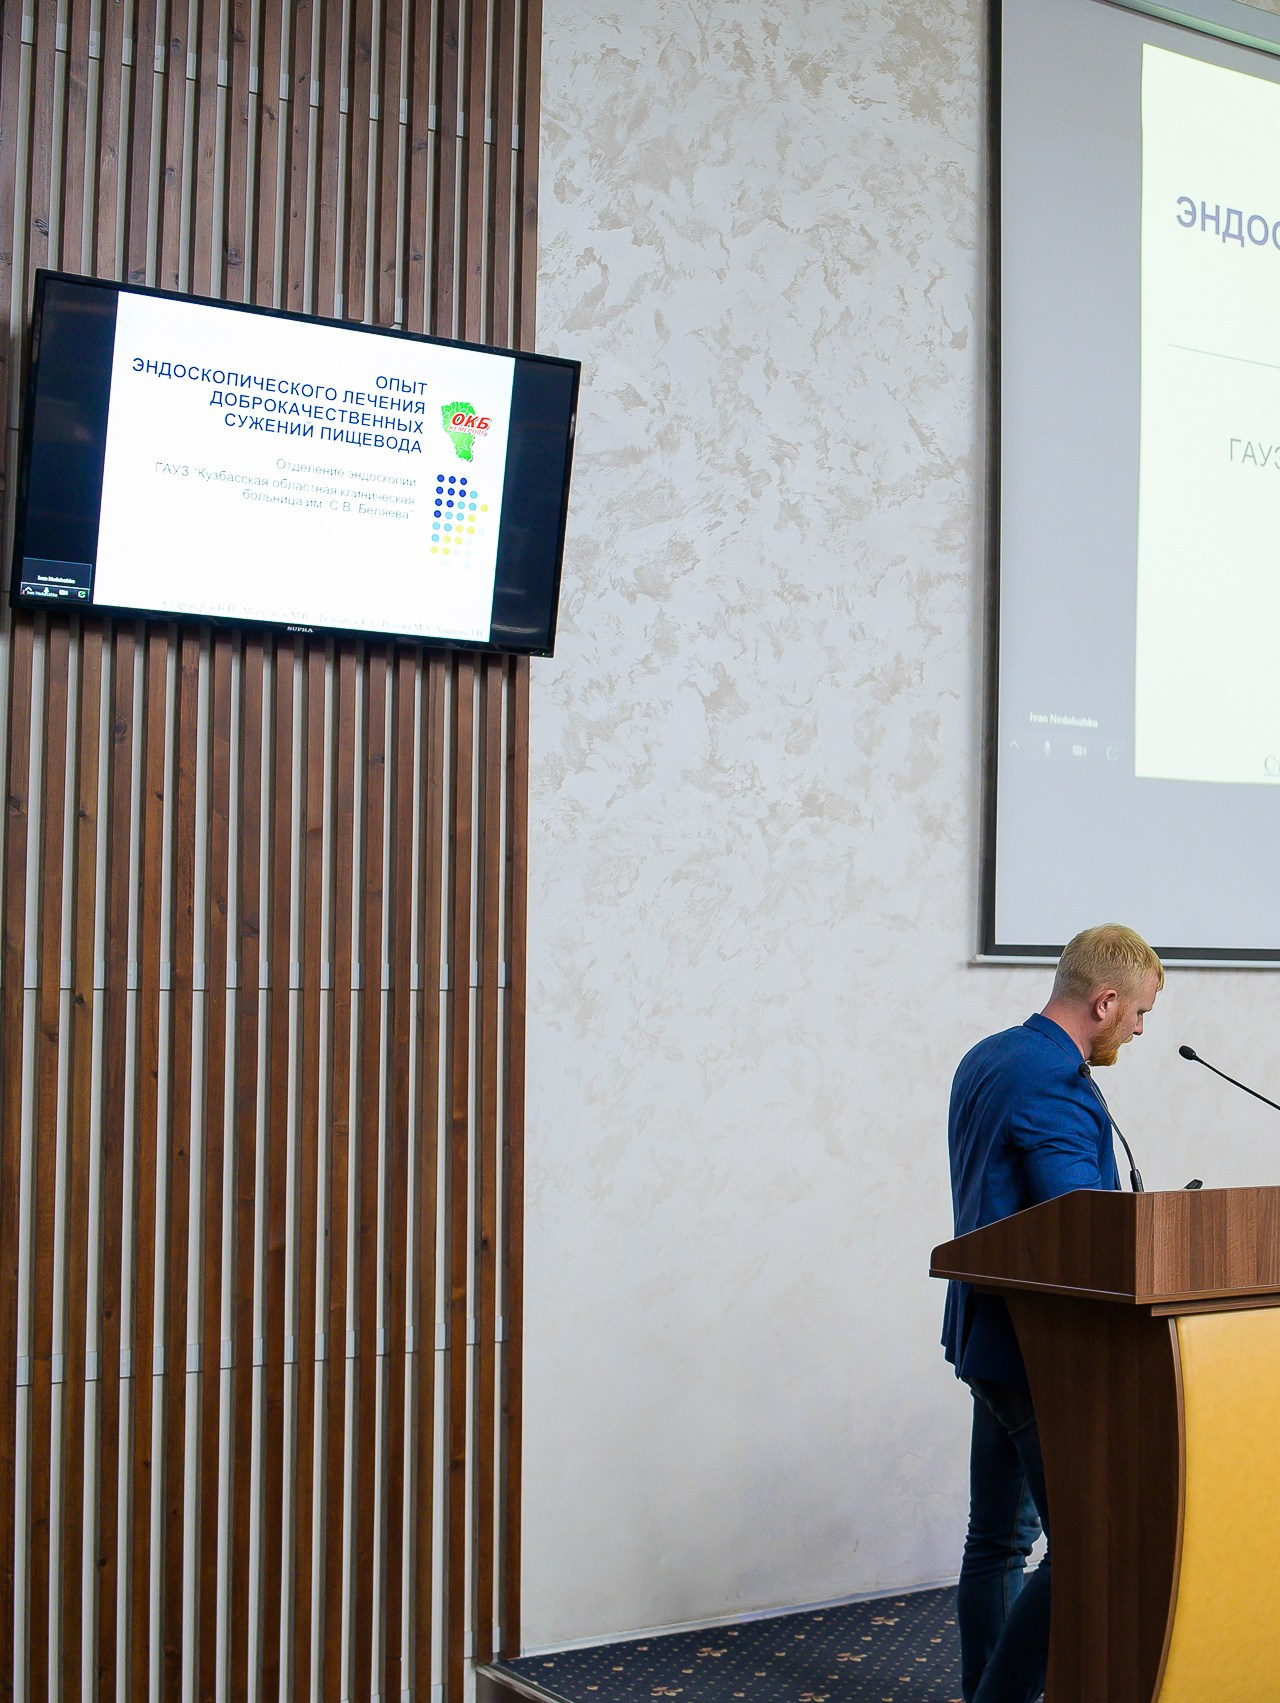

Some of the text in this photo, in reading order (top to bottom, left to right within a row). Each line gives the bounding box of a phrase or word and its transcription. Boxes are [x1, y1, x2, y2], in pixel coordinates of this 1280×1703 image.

[132, 357, 426, 415] ЭНДОСКОПИЧЕСКОГО ЛЕЧЕНИЯ
[375, 375, 428, 396] ОПЫТ
[209, 390, 425, 435] ДОБРОКАЧЕСТВЕННЫХ
[451, 413, 491, 429] ОКБ
[224, 412, 423, 454] СУЖЕНИЙ ПИЩЕВОДА
[154, 461, 190, 478] ГАУЗ
[272, 477, 338, 497] областная
[340, 488, 415, 506] клиническая
[276, 458, 417, 488] Отделение эндоскопии
[242, 488, 303, 508] больница
[1029, 711, 1048, 724] Ivan
